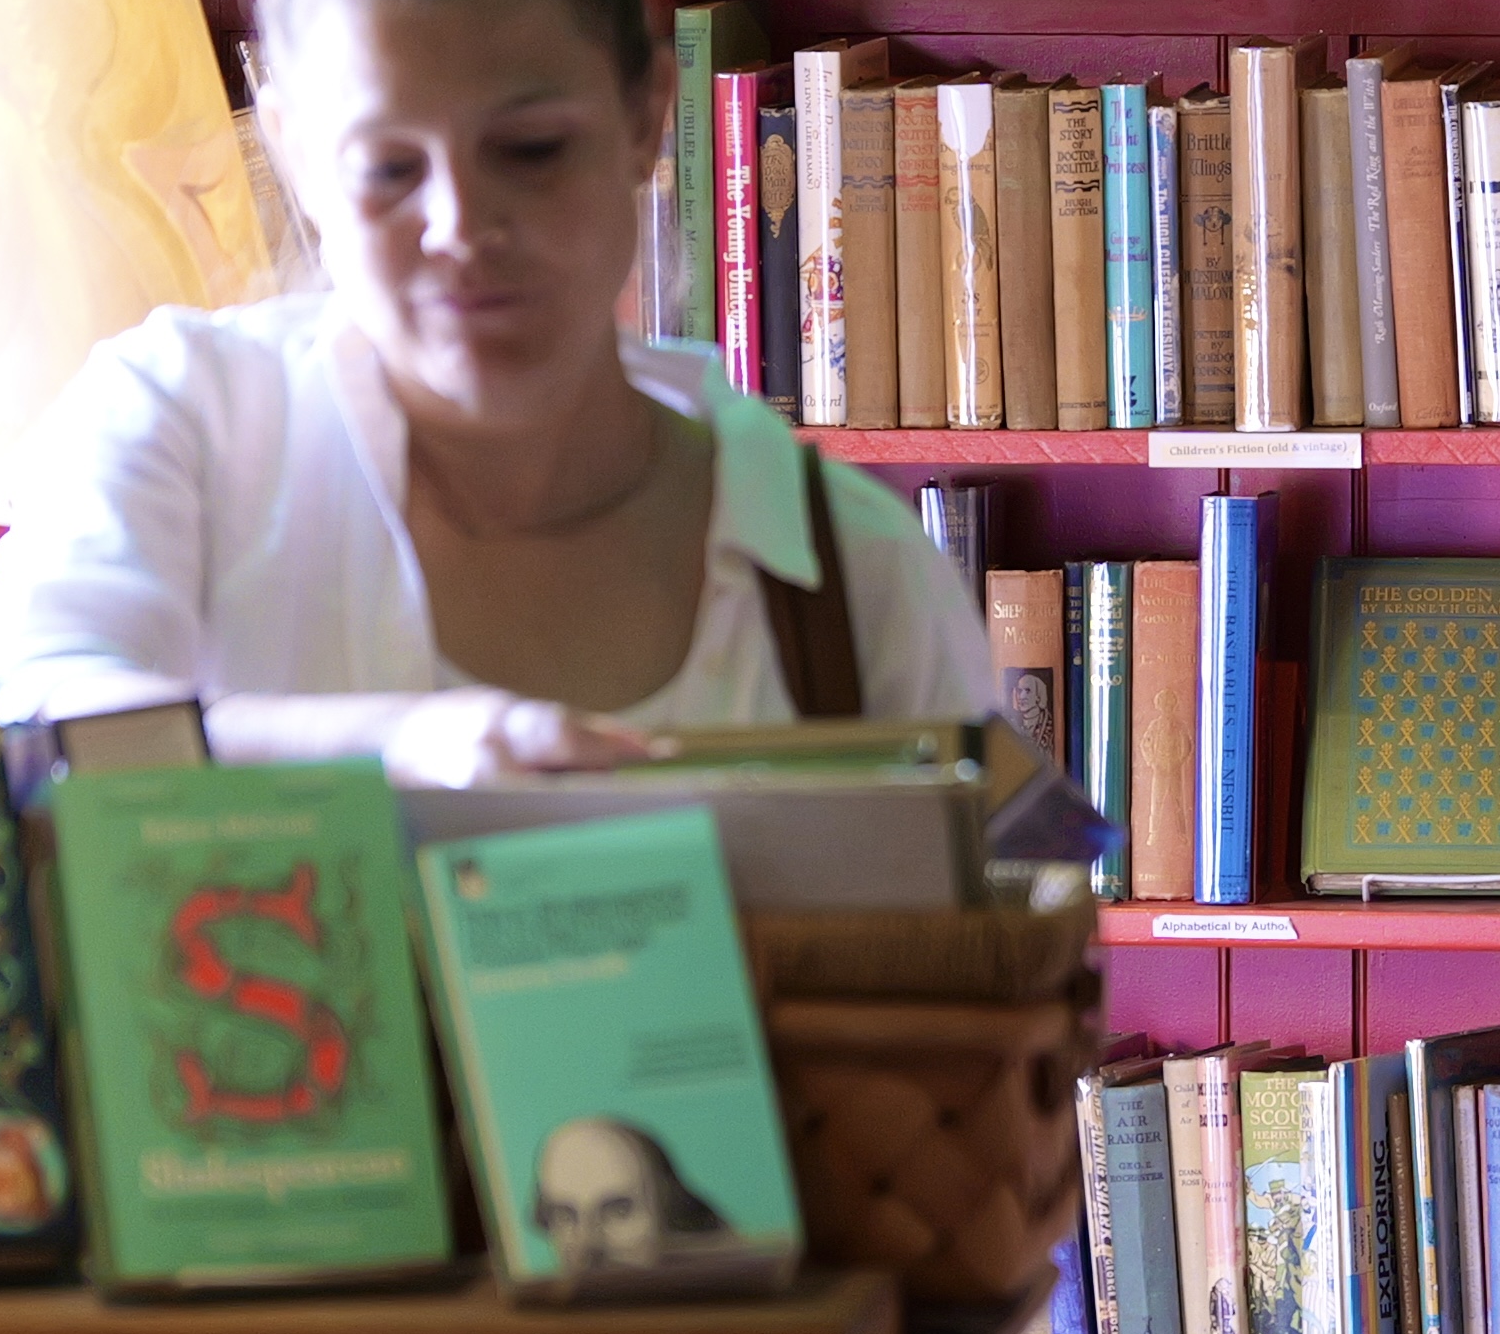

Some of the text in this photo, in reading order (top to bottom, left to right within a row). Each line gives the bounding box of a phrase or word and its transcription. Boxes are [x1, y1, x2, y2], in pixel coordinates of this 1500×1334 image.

[1064, 117, 1087, 129] THE
[1059, 128, 1094, 142] STORY
[1071, 140, 1084, 150] OF
[1186, 134, 1232, 151] Brittle
[1056, 150, 1096, 163] DOCTOR
[1055, 160, 1099, 175] DOLITTLE
[1190, 157, 1232, 183] Wings
[1064, 198, 1092, 208] HUGH
[1157, 188, 1167, 213] The
[1058, 207, 1098, 218] LOFTING
[1159, 214, 1169, 246] HIGH
[1161, 294, 1171, 308] of
[1368, 401, 1398, 414] Oxford
[1169, 440, 1348, 456] Children's Fiction (old & vintage)
[1360, 586, 1404, 604] THE
[1408, 586, 1495, 604] GOLDEN
[1360, 603, 1381, 615] BY
[1384, 603, 1461, 615] KENNETH
[1161, 922, 1231, 933] Alphabetical
[1234, 922, 1247, 933] by
[171, 859, 348, 1123] S
[1174, 1084, 1195, 1093] Child
[1266, 1077, 1297, 1090] THE
[1117, 1101, 1145, 1112] THE
[1117, 1115, 1148, 1128] AIR
[1179, 1115, 1193, 1125] Air
[1107, 1132, 1162, 1146] RANGER
[1110, 1172, 1165, 1183] ROCHESTER
[1178, 1169, 1202, 1177] DIANA
[1182, 1178, 1201, 1187] ROSS
[1373, 1140, 1393, 1319] EXPLORING
